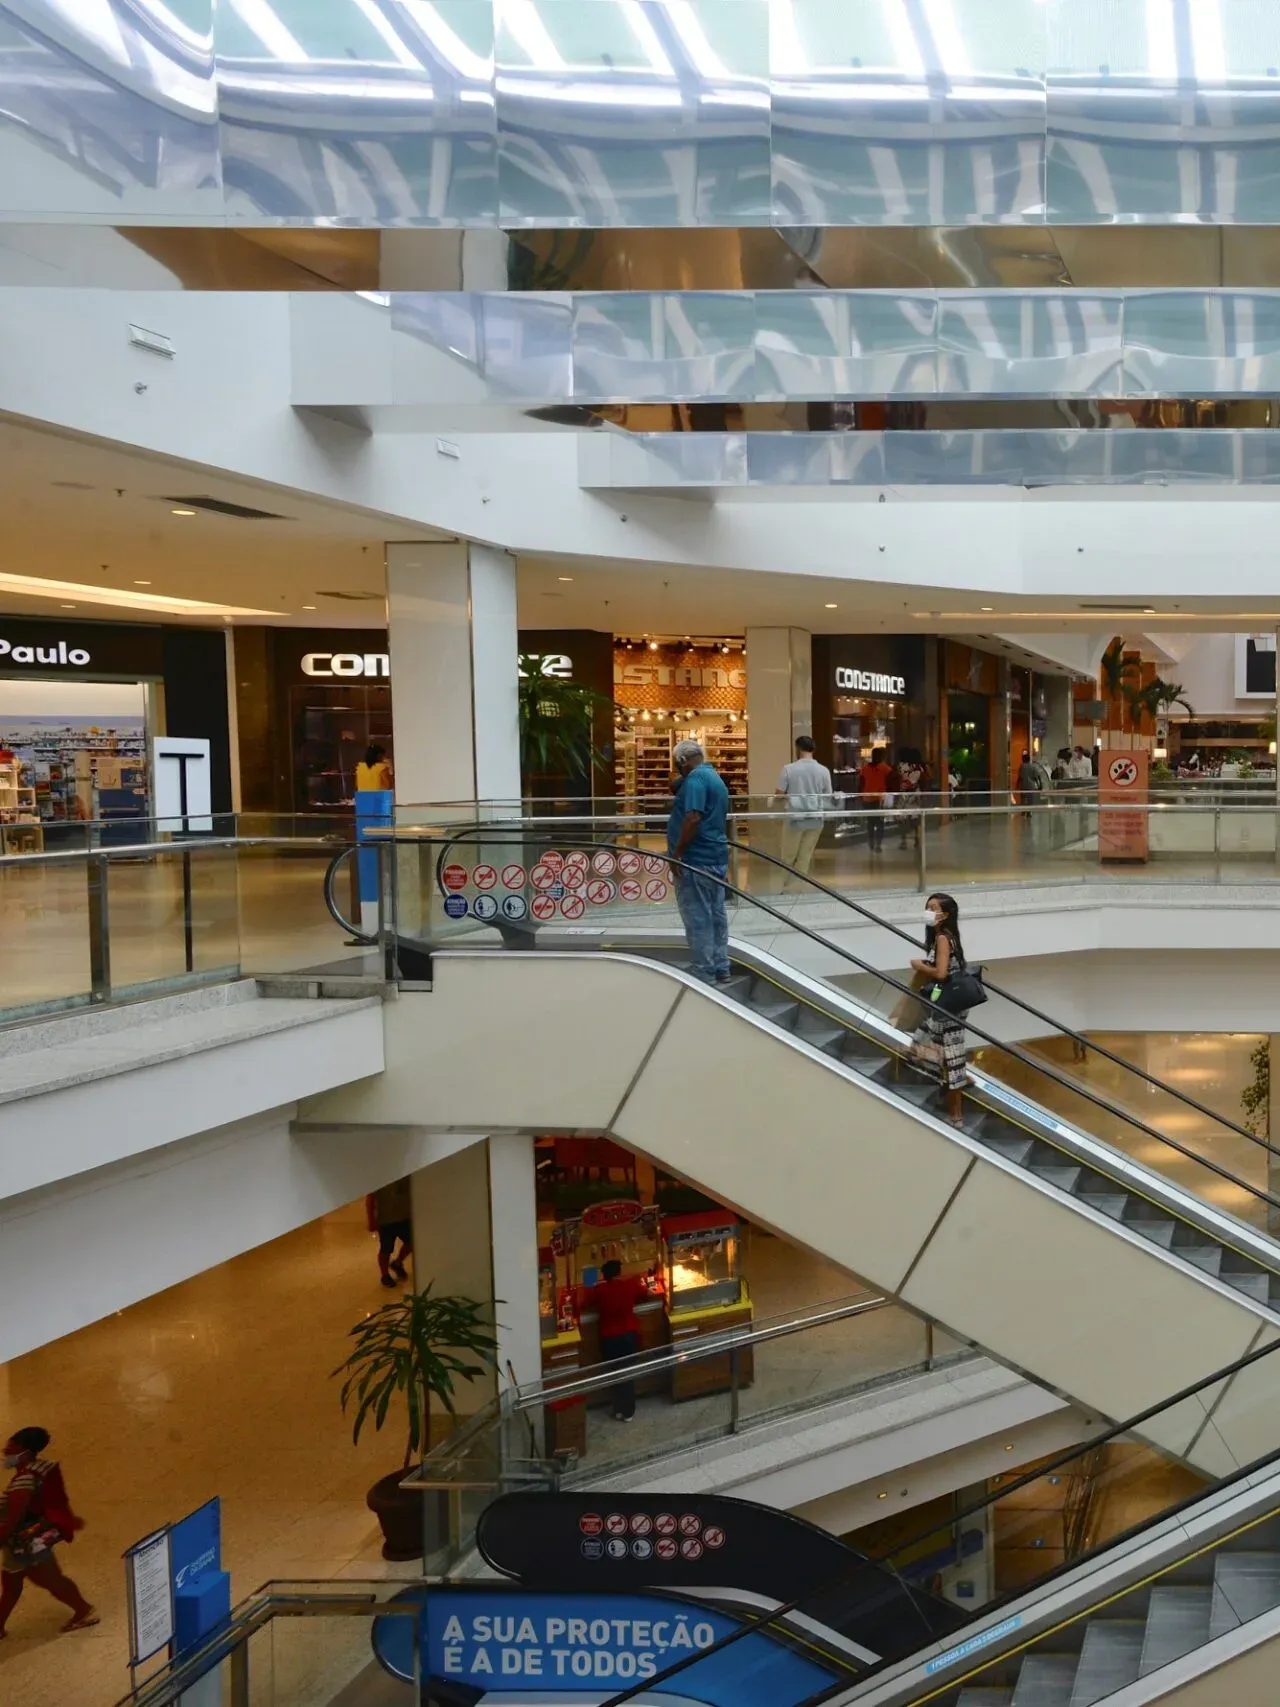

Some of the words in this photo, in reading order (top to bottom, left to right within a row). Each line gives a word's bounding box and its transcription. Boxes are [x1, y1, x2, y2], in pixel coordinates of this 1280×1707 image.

[835, 666, 906, 695] CONSTANCE
[442, 1615, 466, 1642] A
[472, 1616, 538, 1643] SUA
[546, 1614, 715, 1653] PROTEÇÃO
[443, 1638, 463, 1673] É
[470, 1647, 494, 1674] A
[501, 1648, 543, 1675] DE
[551, 1650, 657, 1678] TODOS
